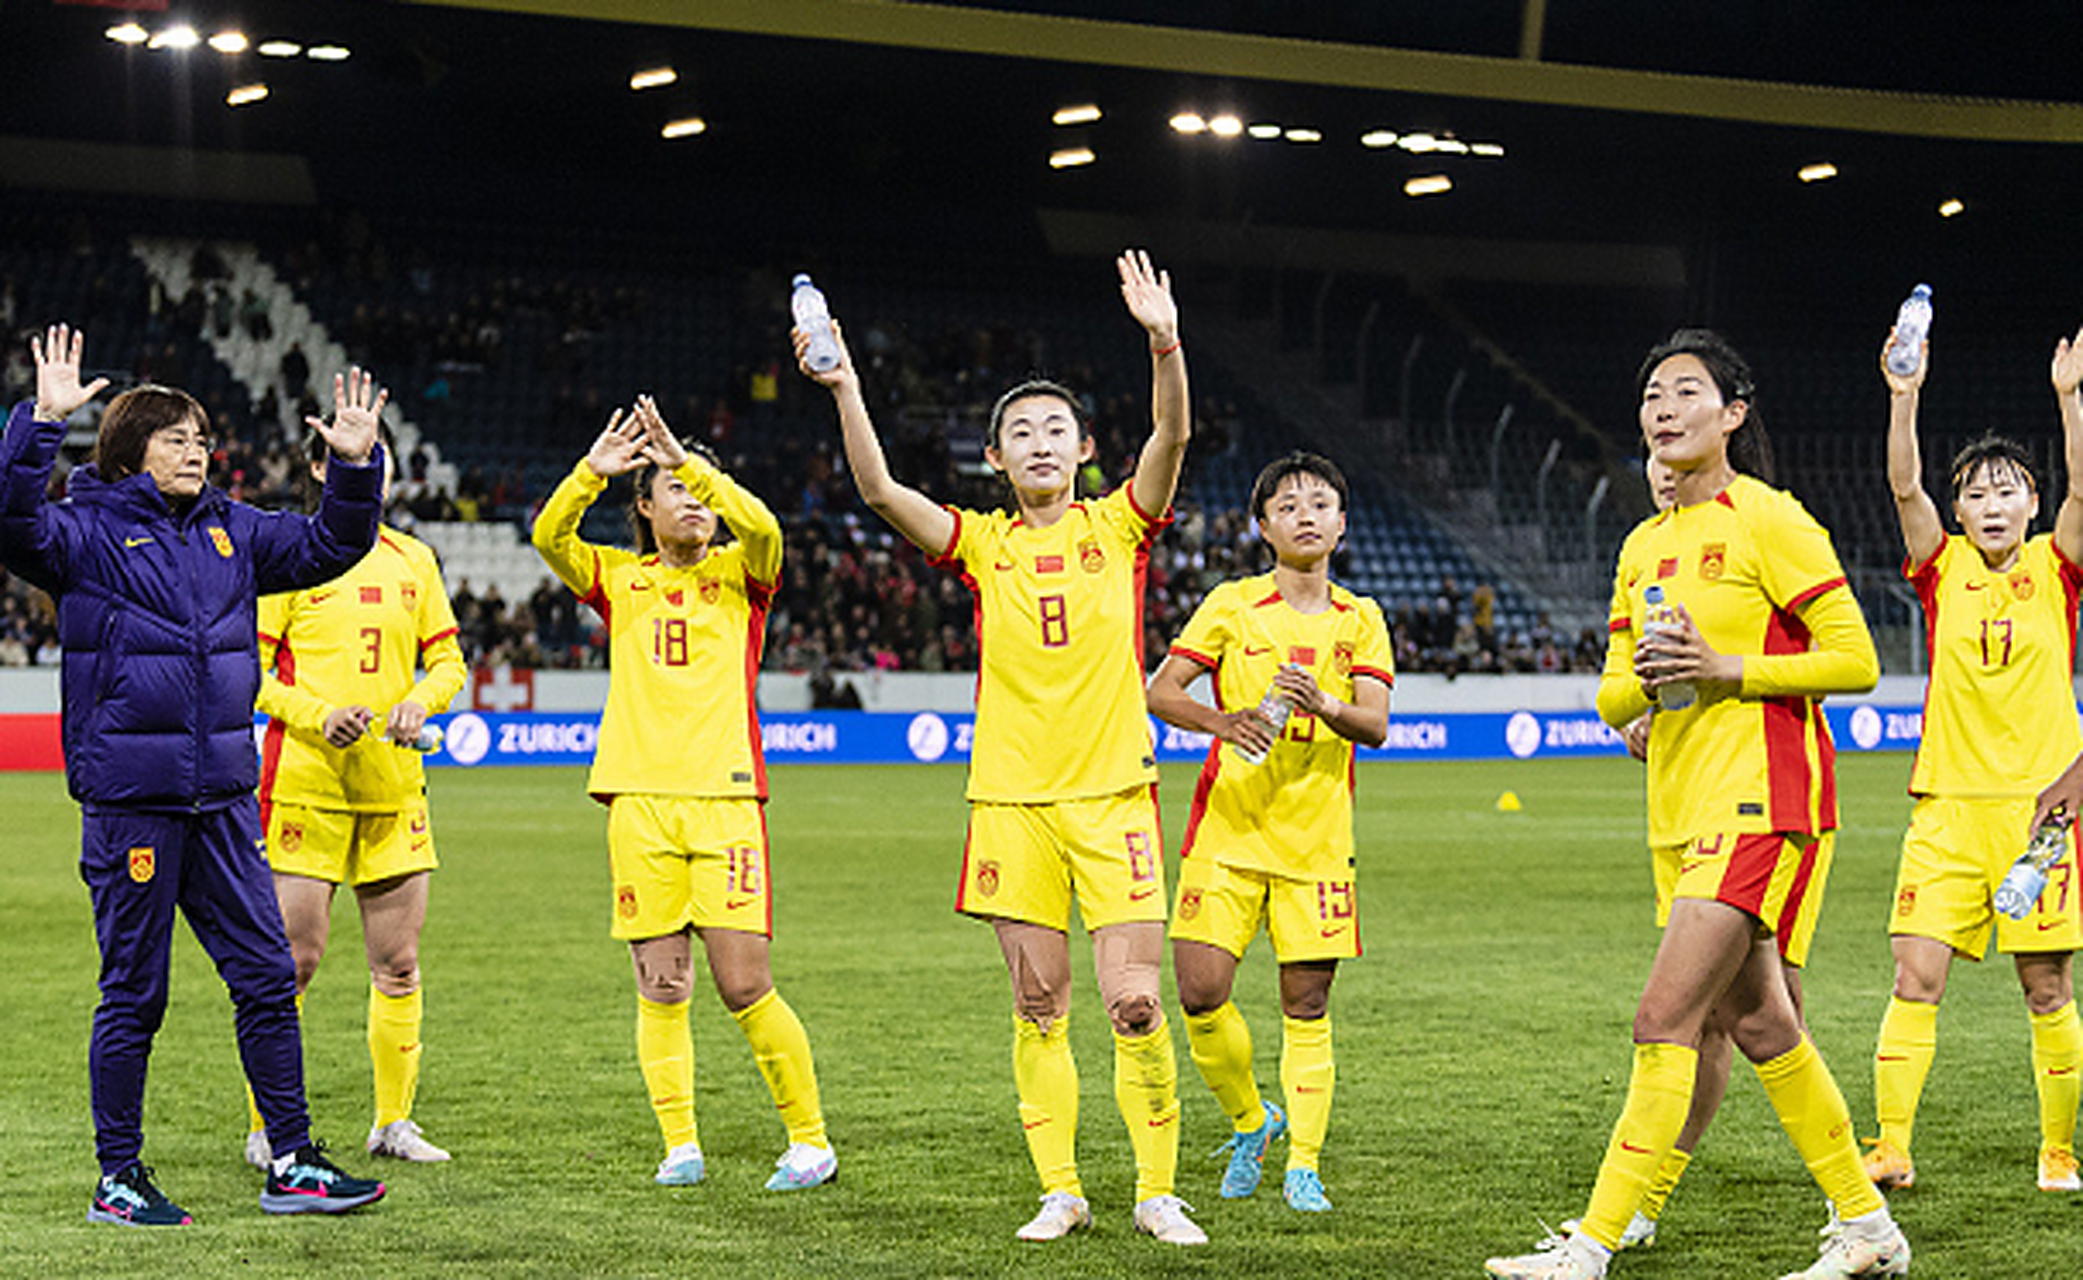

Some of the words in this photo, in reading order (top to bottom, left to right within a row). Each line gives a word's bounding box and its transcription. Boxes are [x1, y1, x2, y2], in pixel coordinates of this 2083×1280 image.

[654, 618, 688, 666] 18
[1039, 594, 1068, 648] 8
[1981, 618, 2011, 666] 17
[360, 628, 381, 673] 3
[726, 847, 761, 895] 18
[1125, 831, 1155, 882] 8
